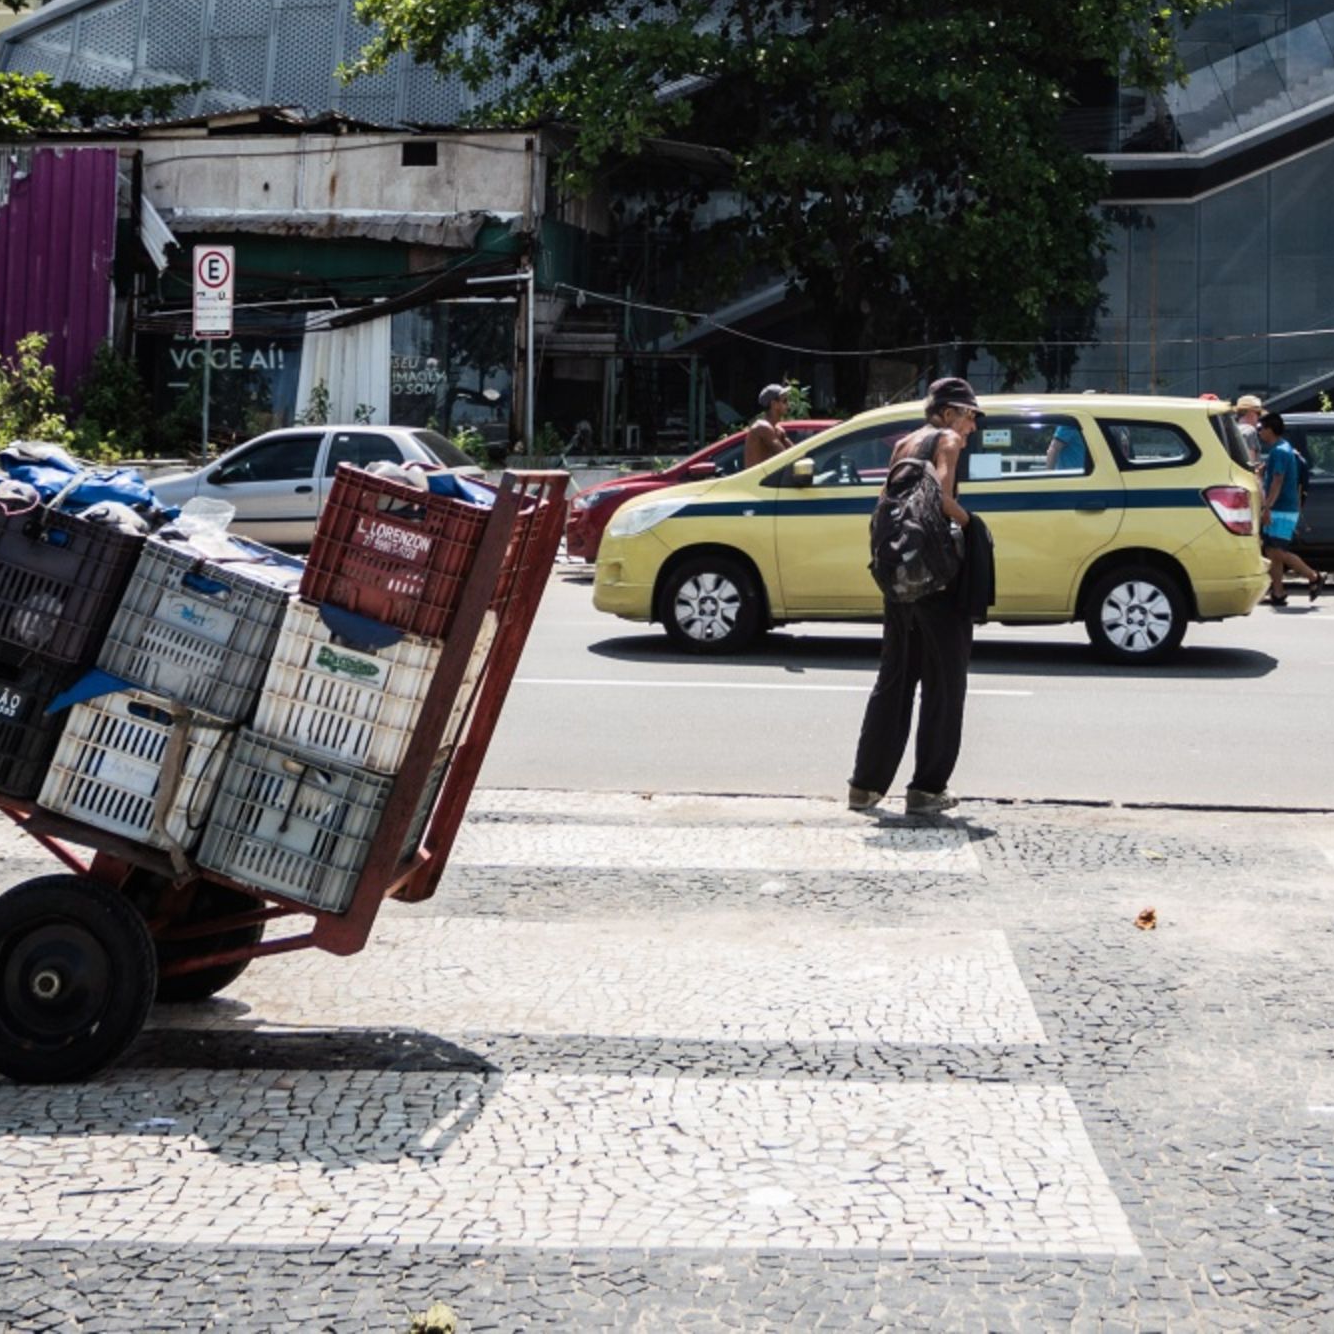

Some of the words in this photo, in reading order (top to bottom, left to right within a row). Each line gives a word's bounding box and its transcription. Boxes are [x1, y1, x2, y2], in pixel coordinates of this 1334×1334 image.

[208, 259, 220, 280] E
[169, 342, 244, 369] VOCÊ
[249, 342, 285, 370] AÍ!
[370, 521, 432, 552] LORENZON
